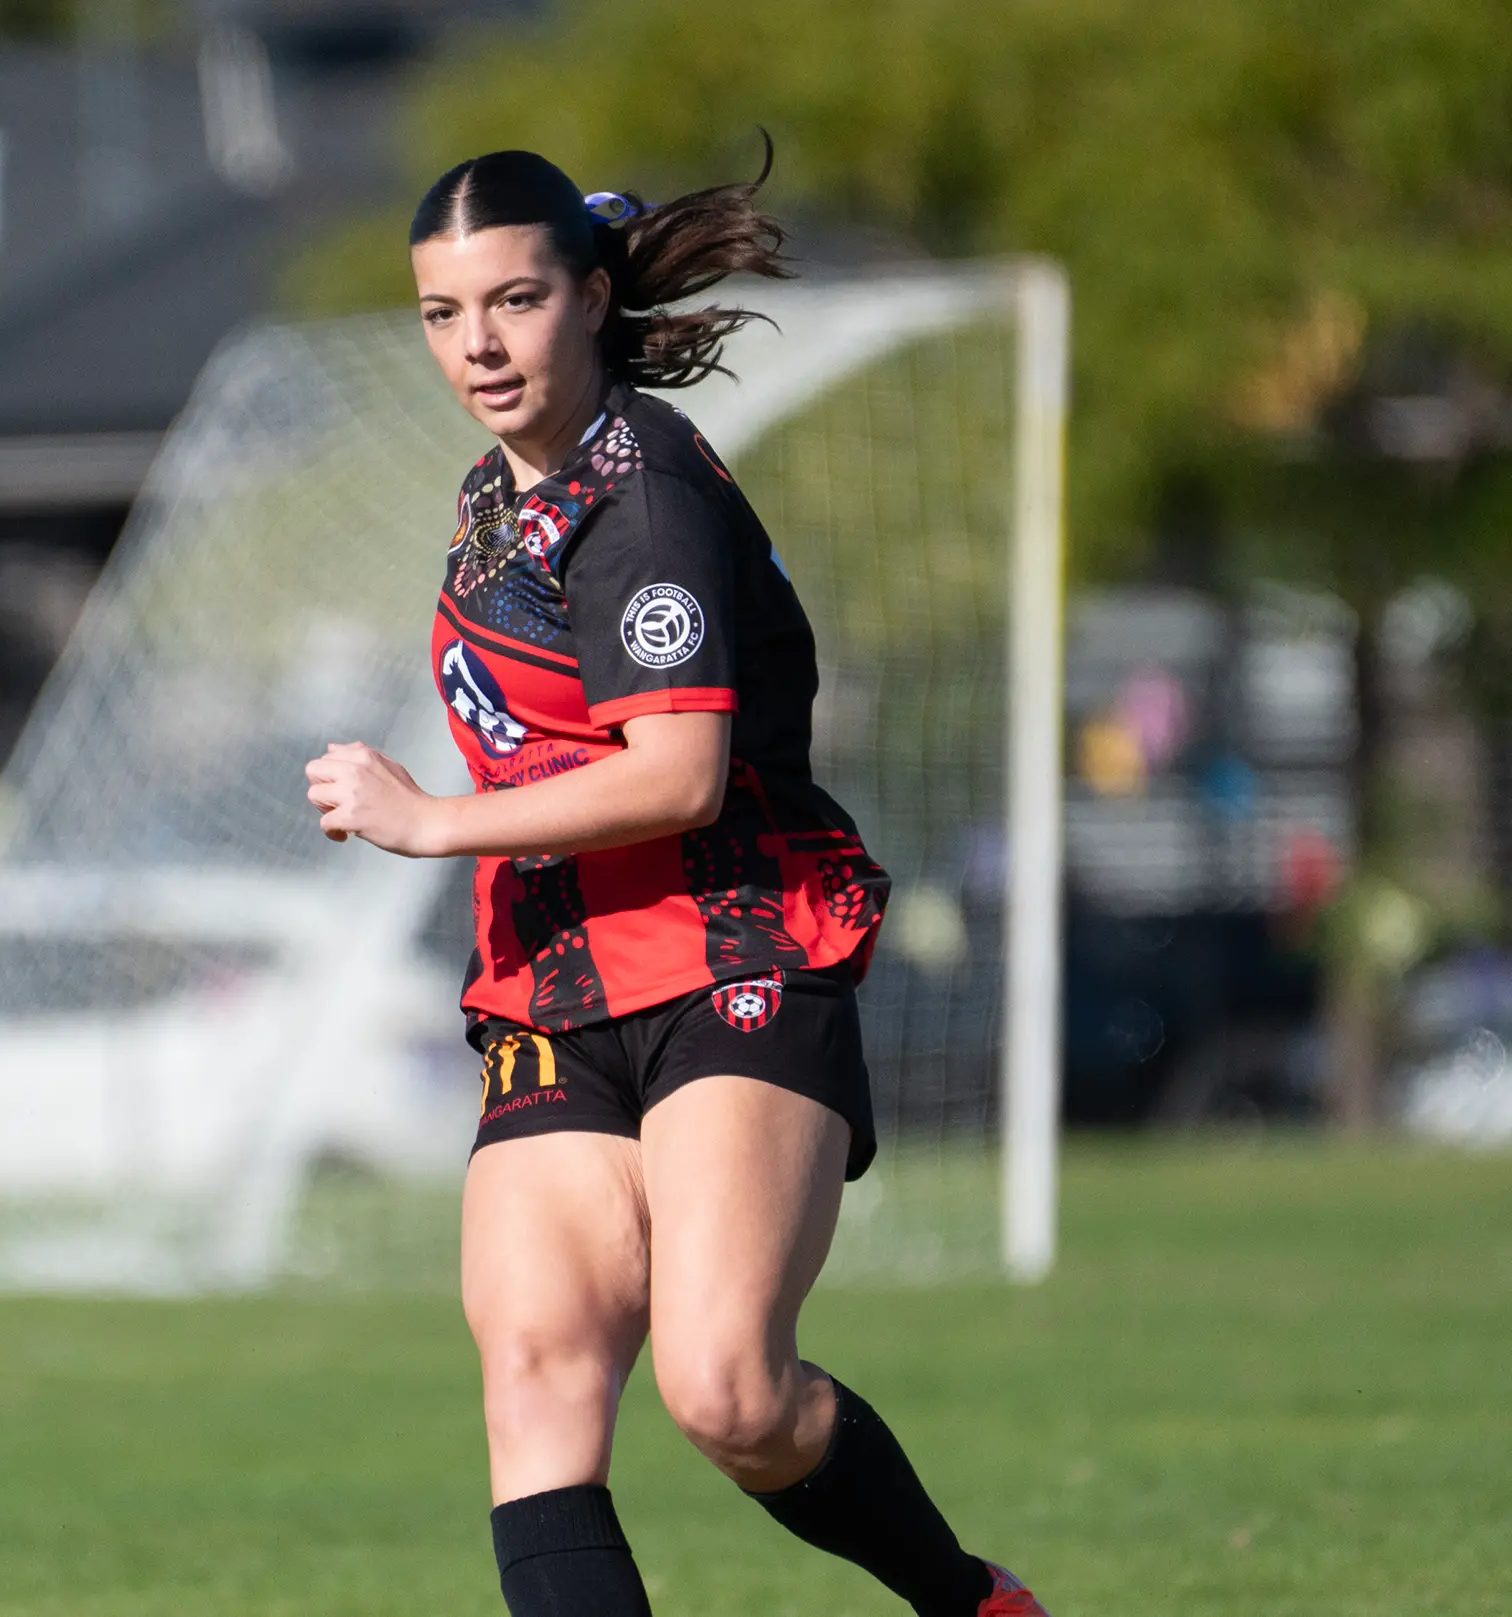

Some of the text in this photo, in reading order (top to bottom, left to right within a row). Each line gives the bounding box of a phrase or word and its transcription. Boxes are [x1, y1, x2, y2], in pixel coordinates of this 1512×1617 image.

[626, 588, 697, 623] THIS IS FOOTBALL
[630, 632, 699, 664] WANGARATTA FC
[528, 748, 590, 782] CLINIC
[479, 1089, 567, 1128] ANGARATTA
